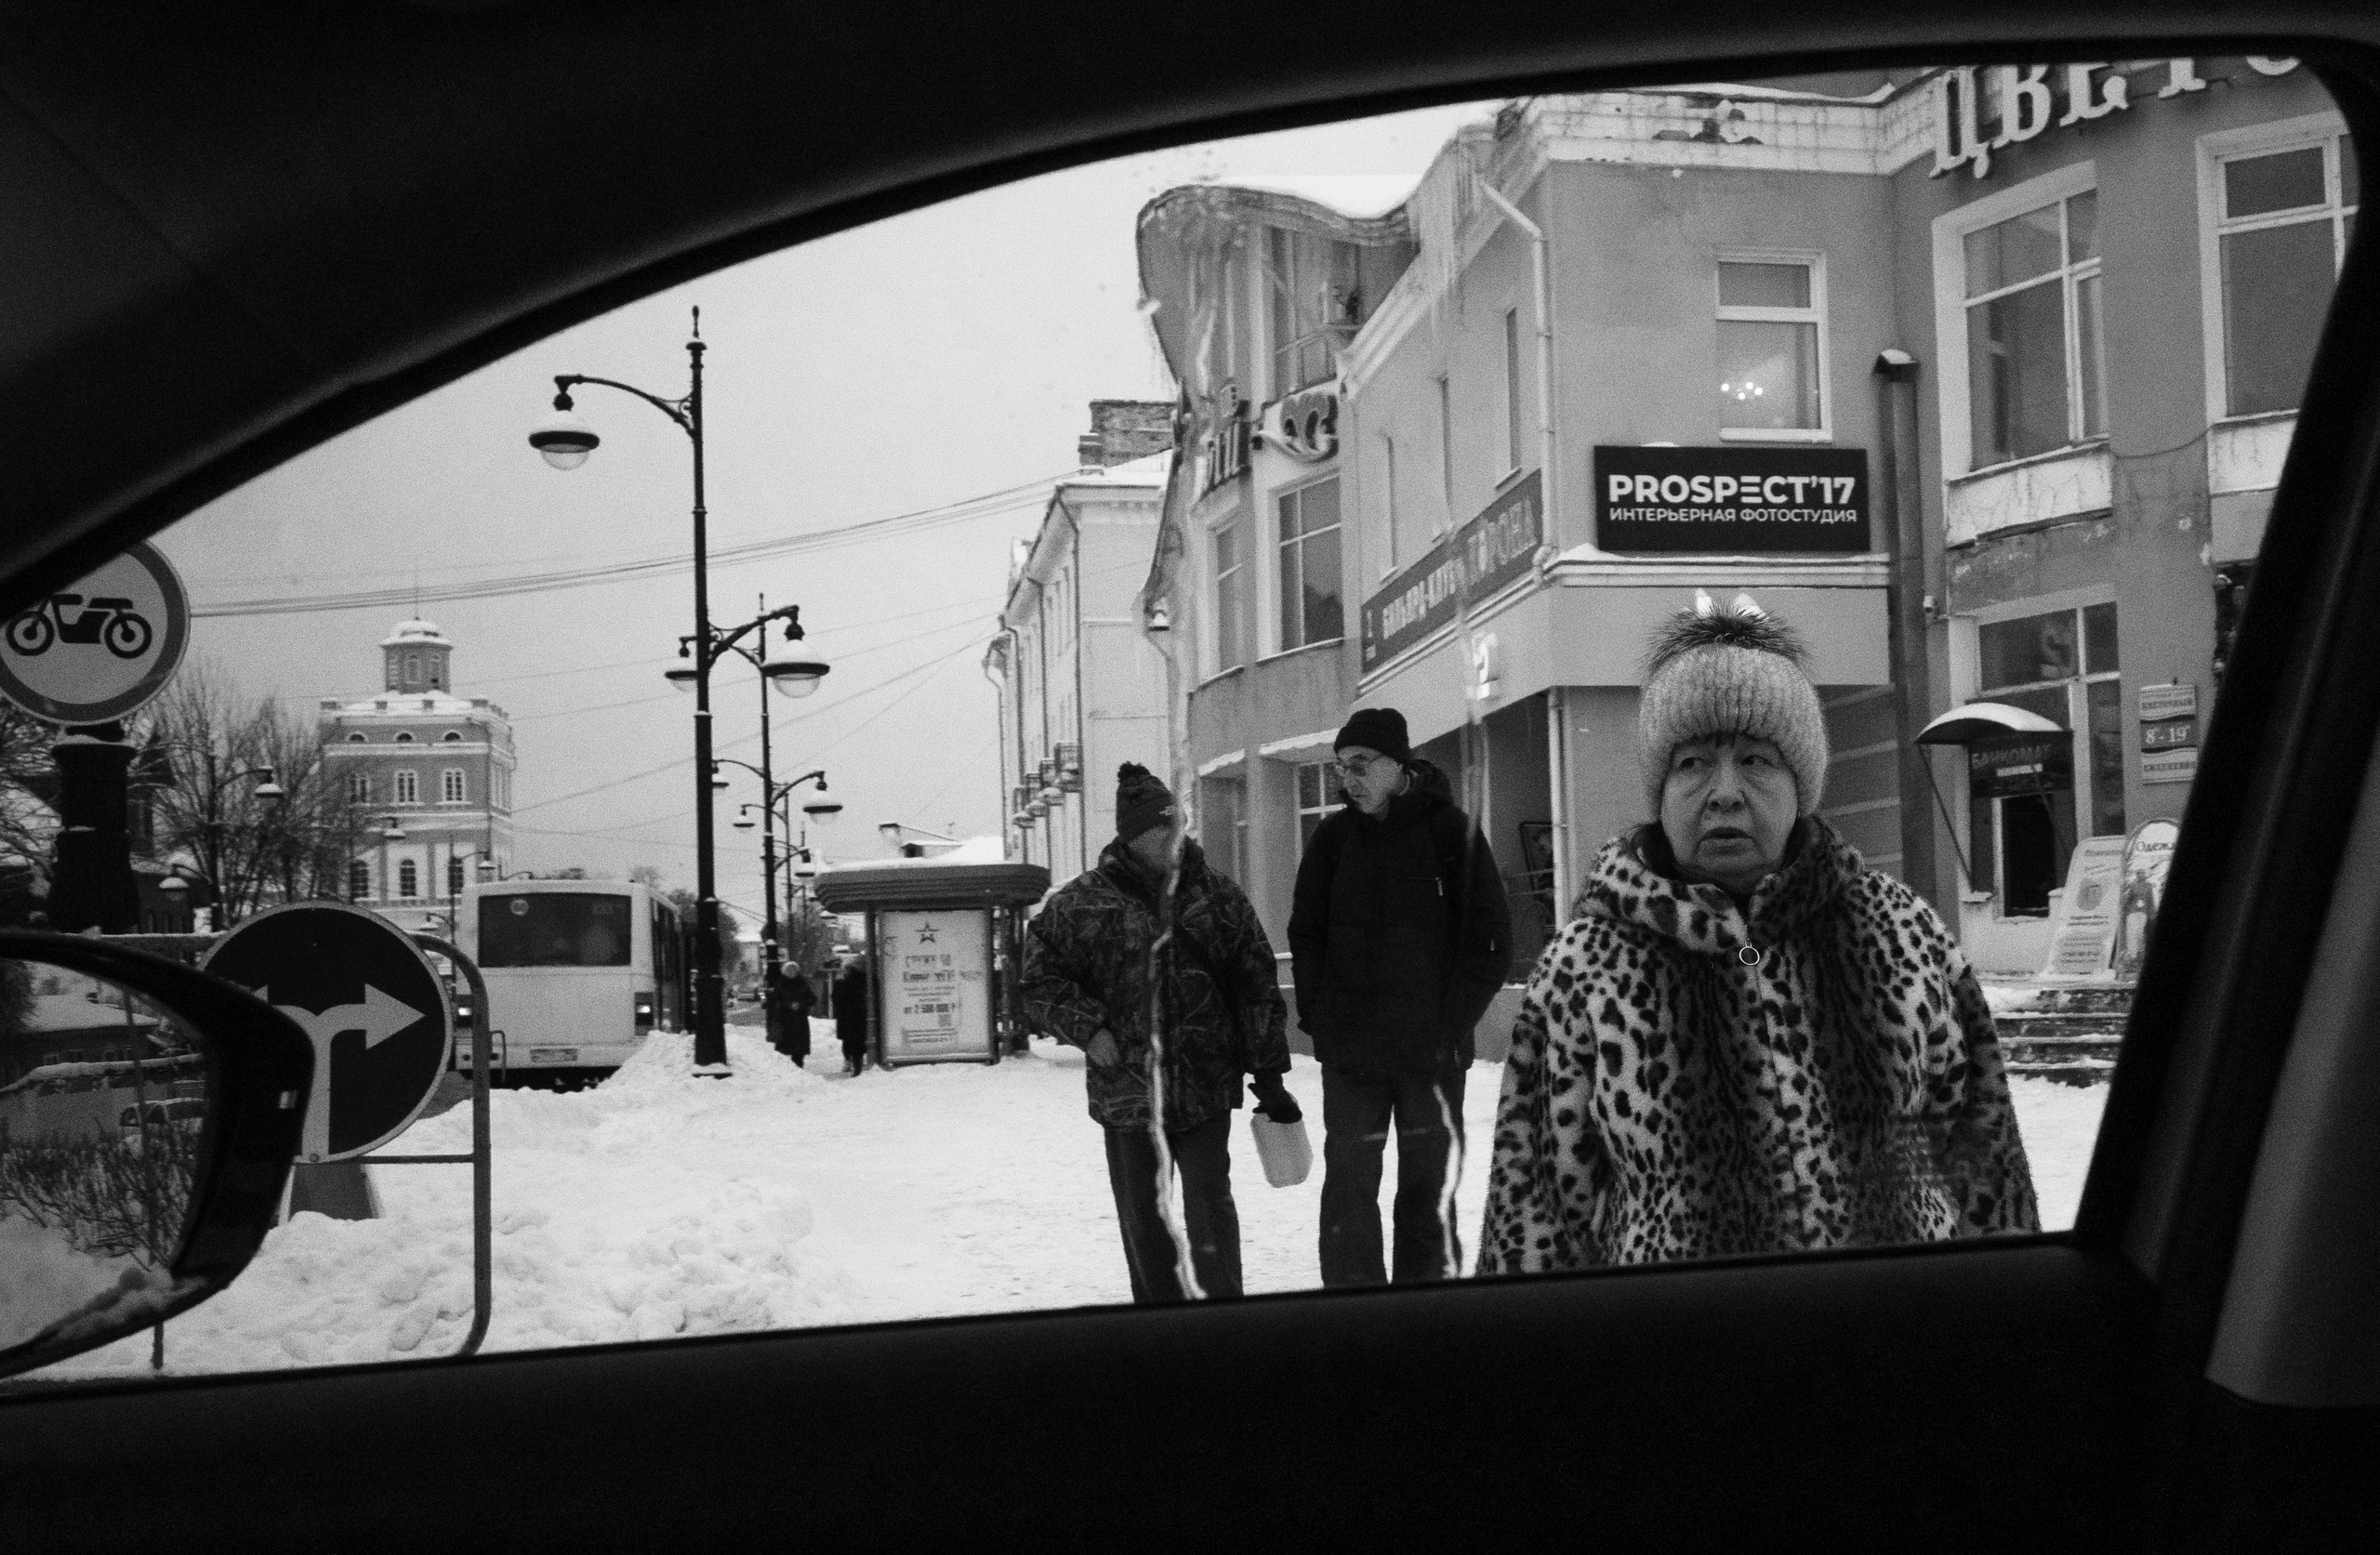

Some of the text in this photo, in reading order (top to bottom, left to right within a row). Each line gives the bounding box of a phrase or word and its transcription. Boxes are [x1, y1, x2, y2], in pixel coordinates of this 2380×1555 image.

[1608, 474, 1856, 505] PROSPECT'17
[1609, 507, 1858, 524] ИНТЕРЬЕРНАЯ ФОТОСТУДИЯ
